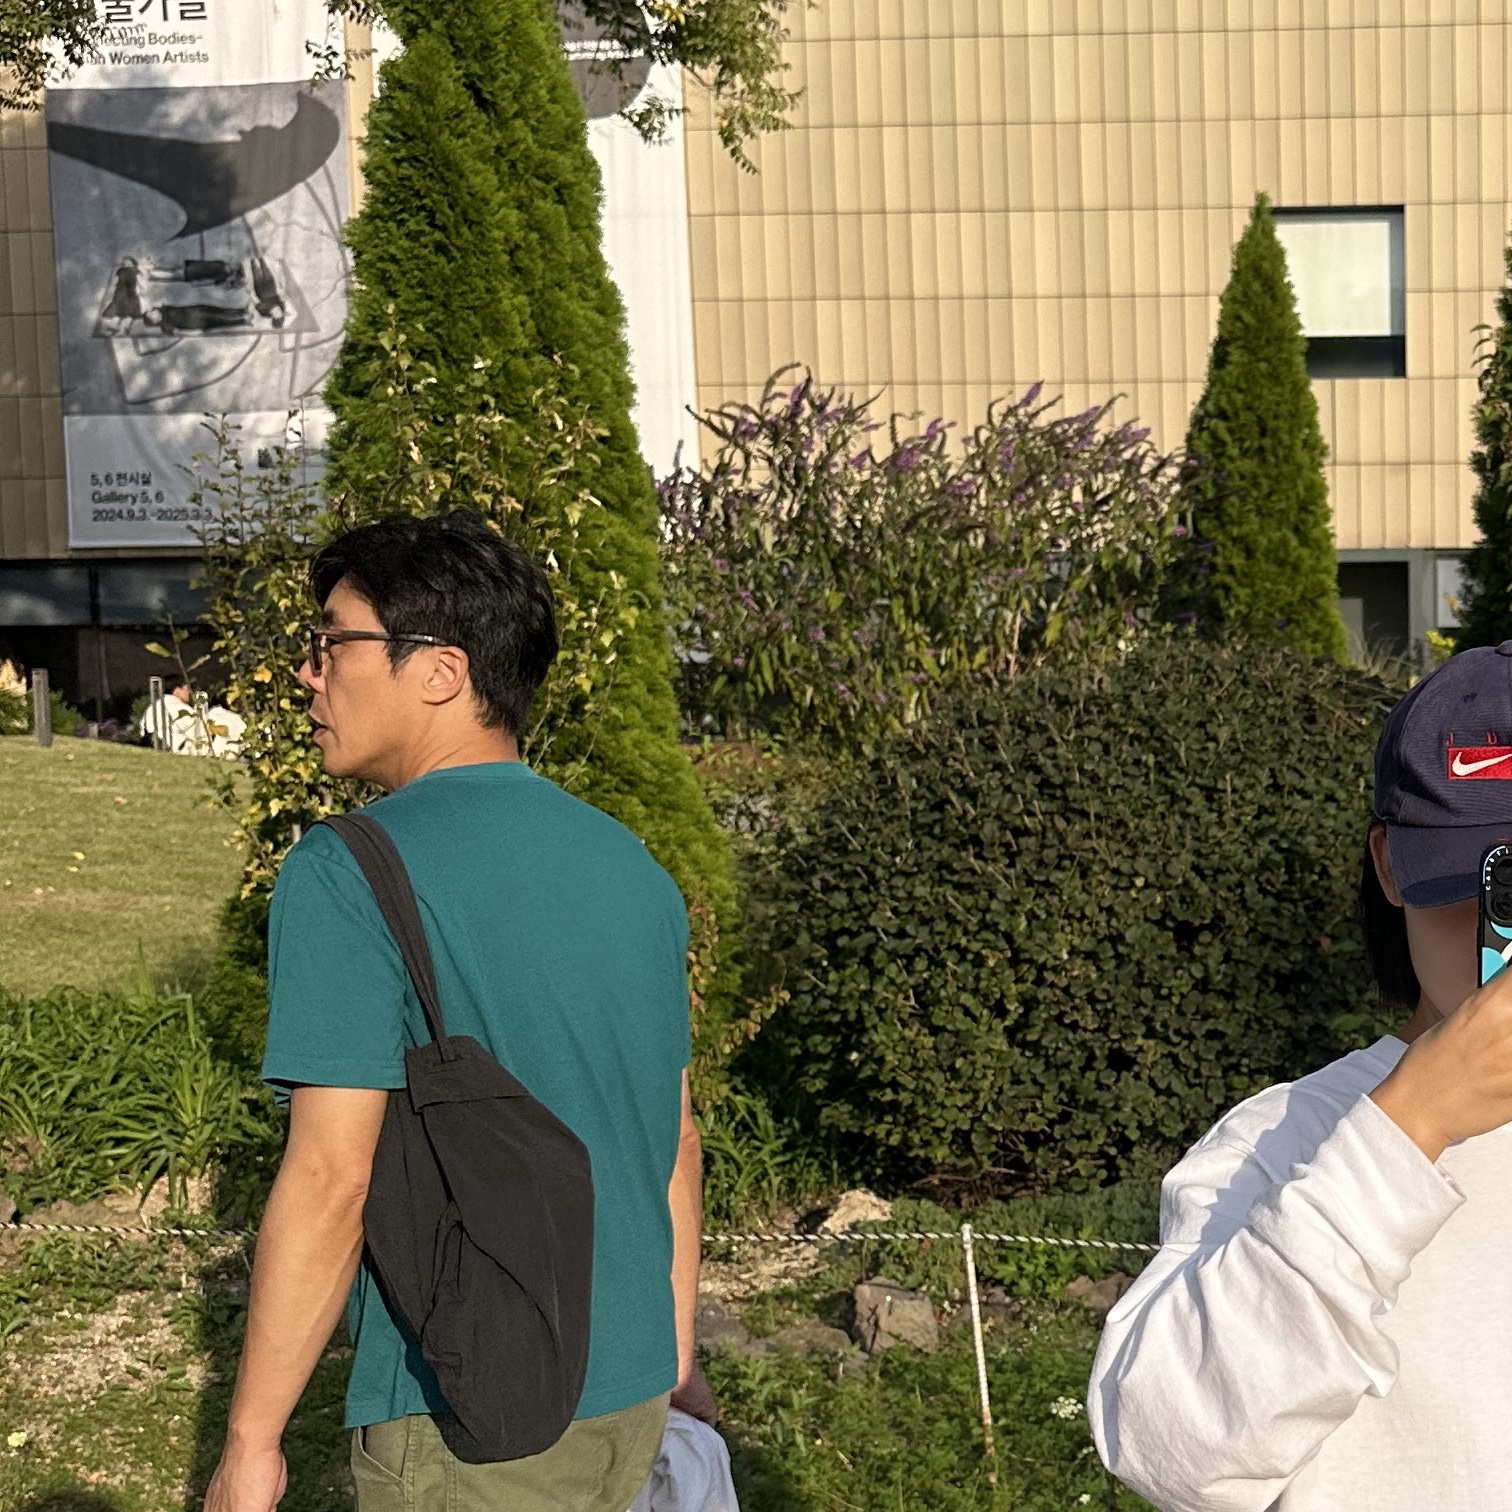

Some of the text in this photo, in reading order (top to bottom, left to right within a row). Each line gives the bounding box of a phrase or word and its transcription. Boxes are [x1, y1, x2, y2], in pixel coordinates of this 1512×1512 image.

[108, 51, 160, 65] Women
[162, 49, 209, 64] Artists
[92, 490, 138, 506] Gallery
